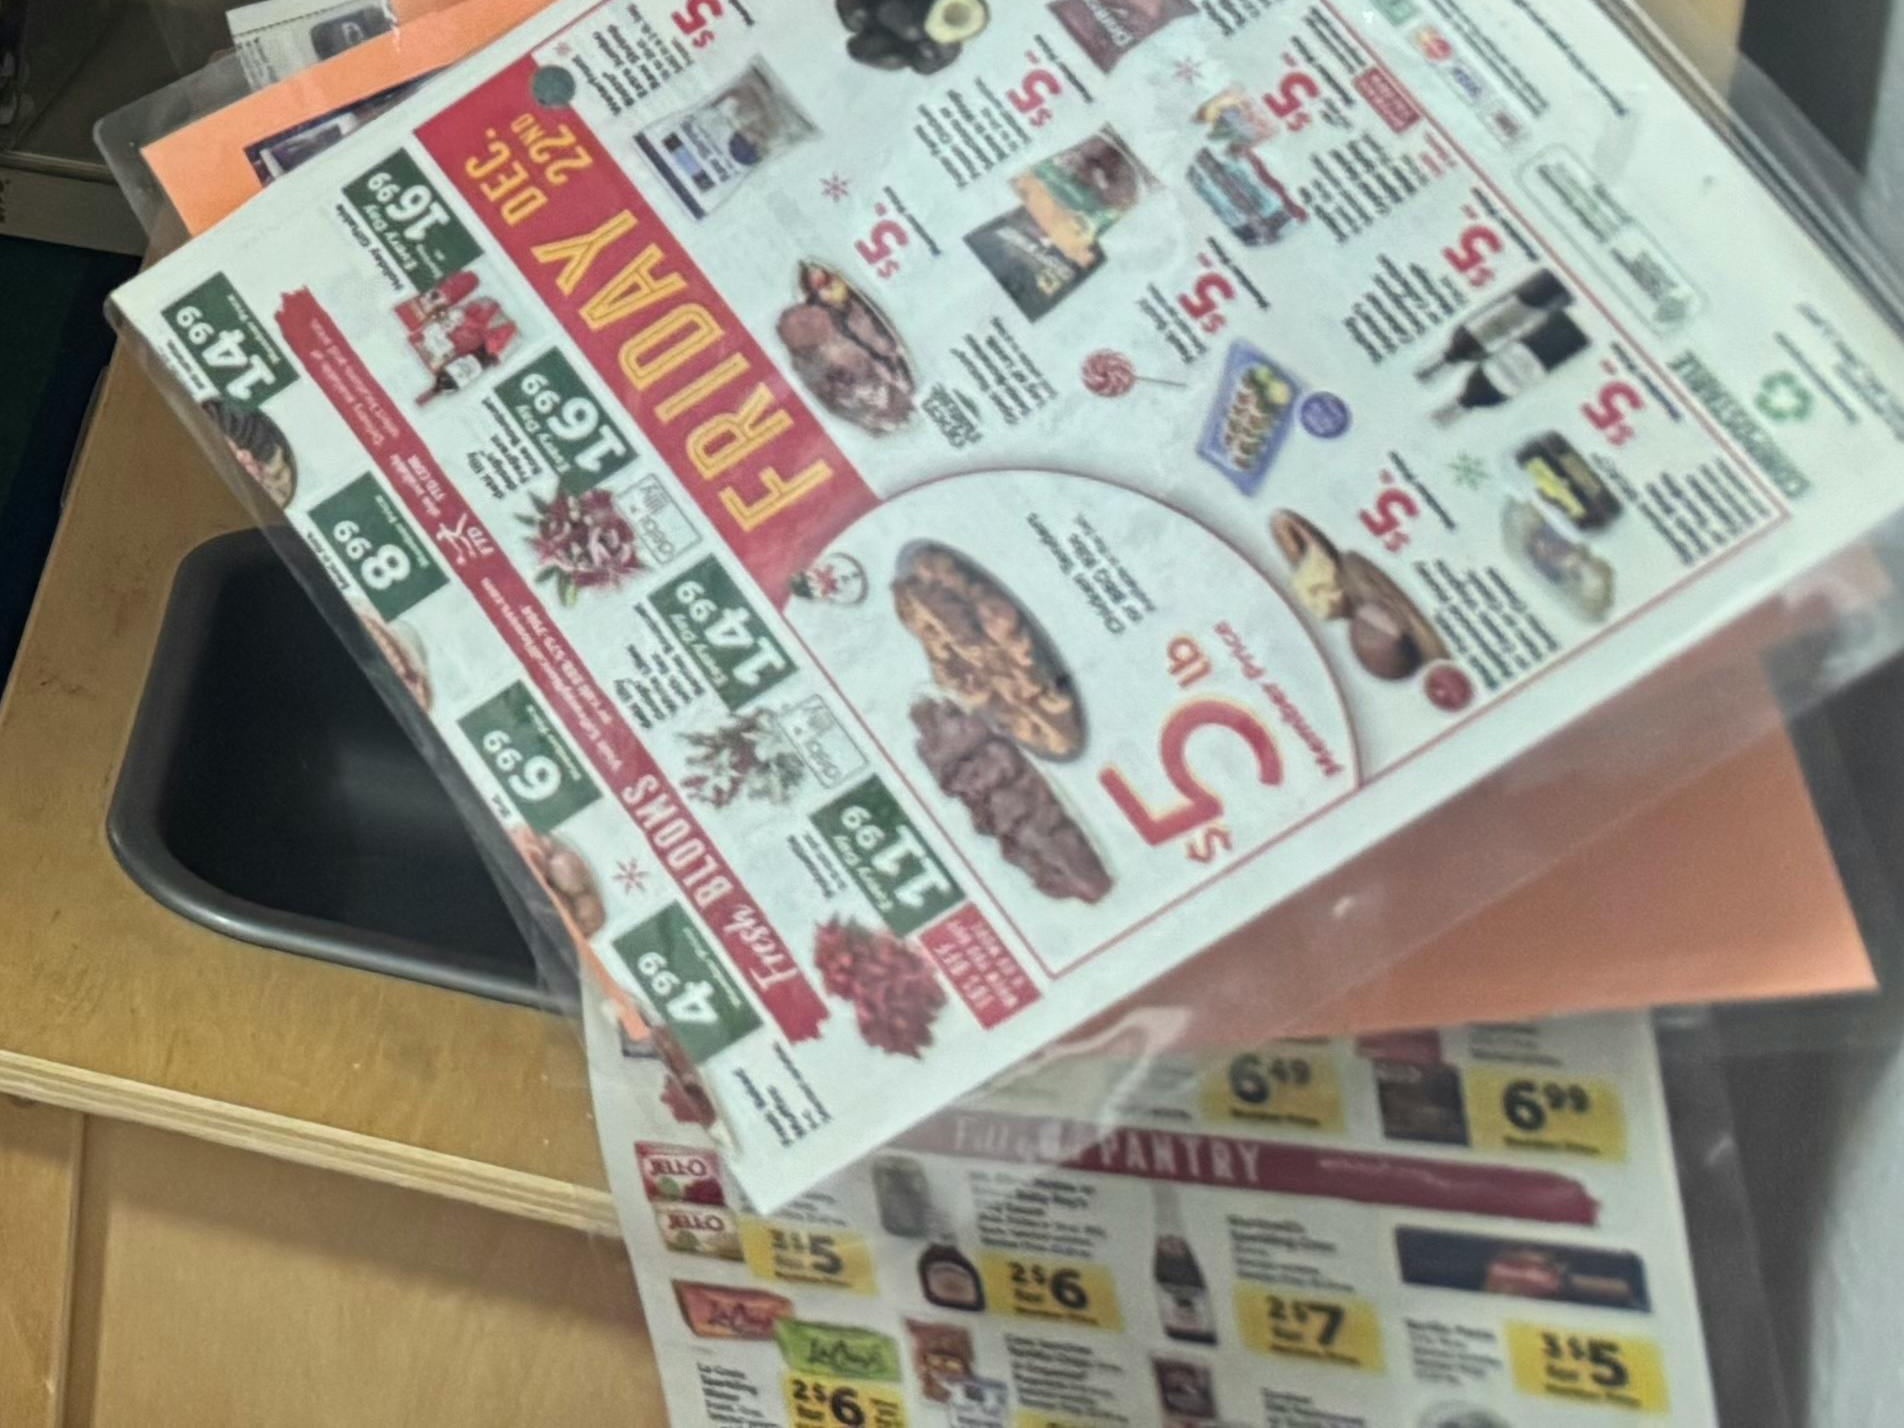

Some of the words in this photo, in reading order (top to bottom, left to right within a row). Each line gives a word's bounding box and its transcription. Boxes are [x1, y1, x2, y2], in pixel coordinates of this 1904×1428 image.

[510, 94, 592, 185] 22ND
[465, 128, 548, 225] DEC.
[363, 204, 387, 231] Day
[384, 231, 417, 270] Every
[531, 209, 834, 532] FRIDAY
[515, 404, 540, 433] Day
[538, 433, 570, 472] Every
[466, 526, 494, 555] FTD
[670, 613, 697, 644] Day
[1214, 621, 1266, 680] Price
[1167, 636, 1211, 688] lb
[1261, 683, 1342, 777] Member
[621, 774, 733, 907] BLOOMS
[723, 904, 802, 990] Fresh
